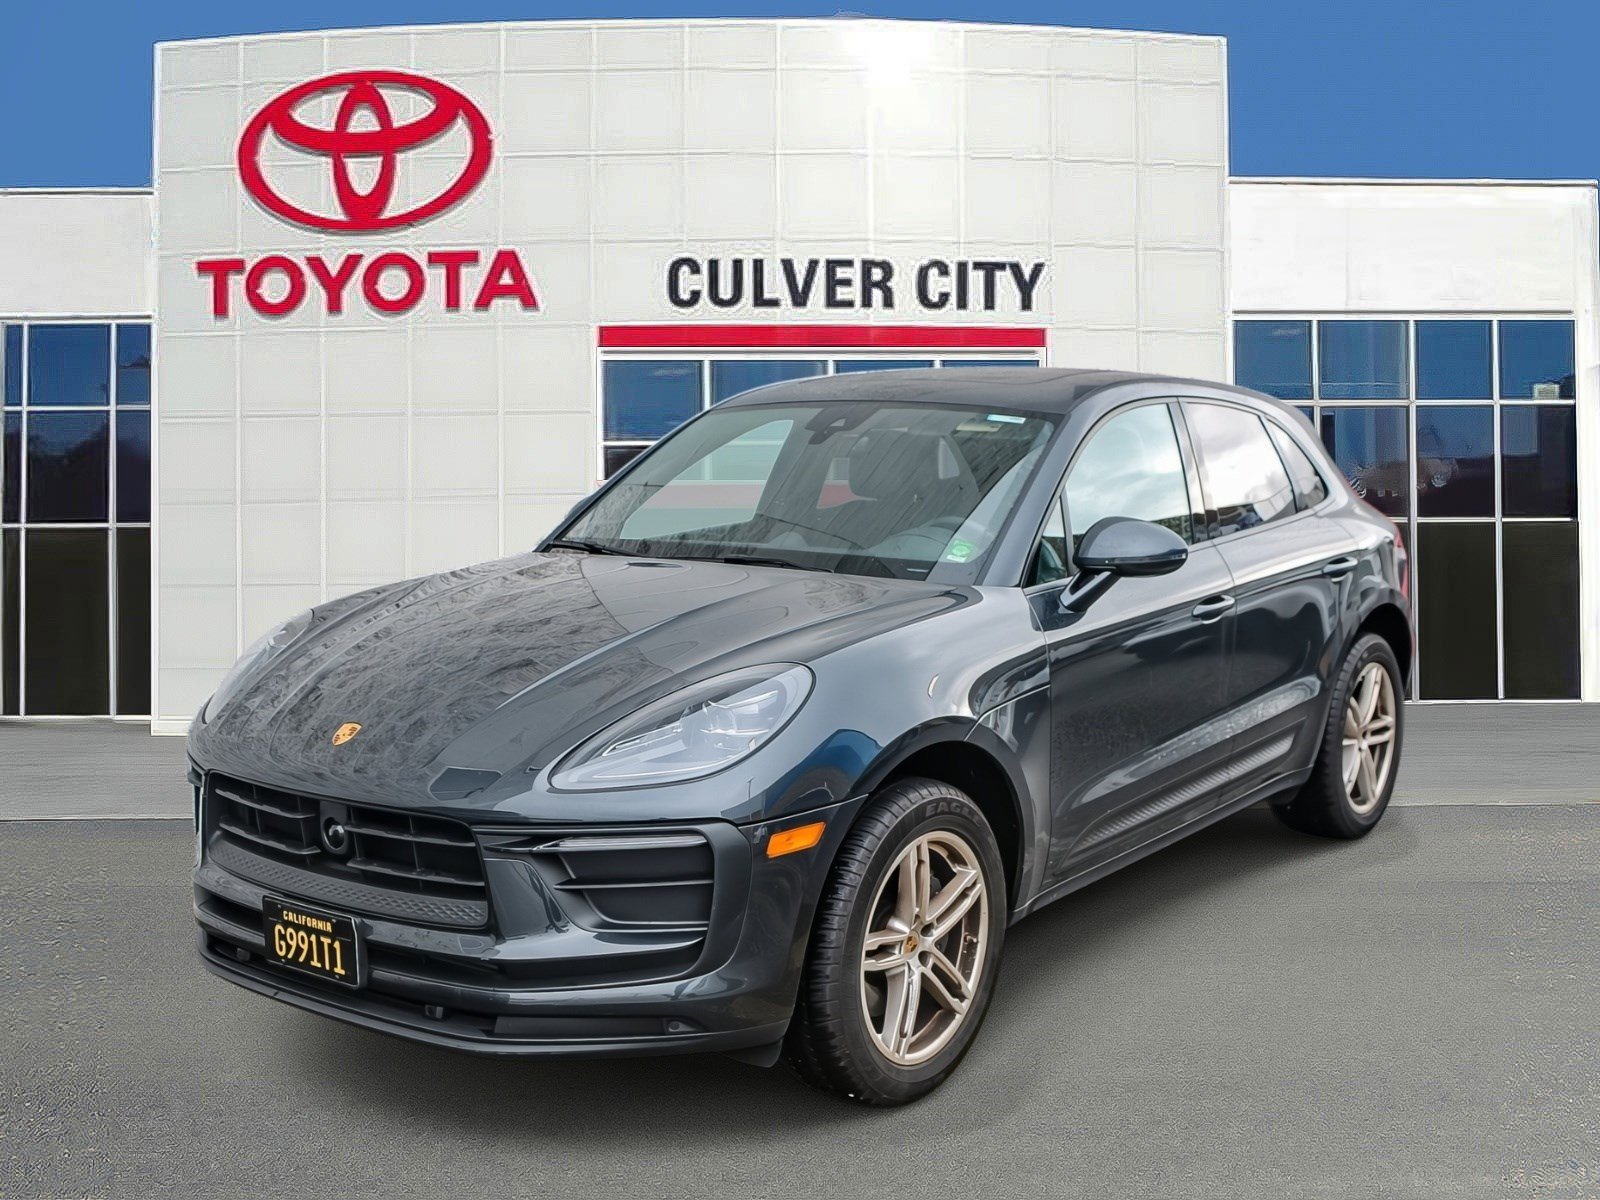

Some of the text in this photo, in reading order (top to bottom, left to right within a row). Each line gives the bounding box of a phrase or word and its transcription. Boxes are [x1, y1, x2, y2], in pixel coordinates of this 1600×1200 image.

[195, 249, 537, 318] TOYOTA
[667, 258, 1045, 311] CULVER CITY
[283, 910, 332, 933] CALIFORNIA
[274, 923, 346, 975] G991T1
